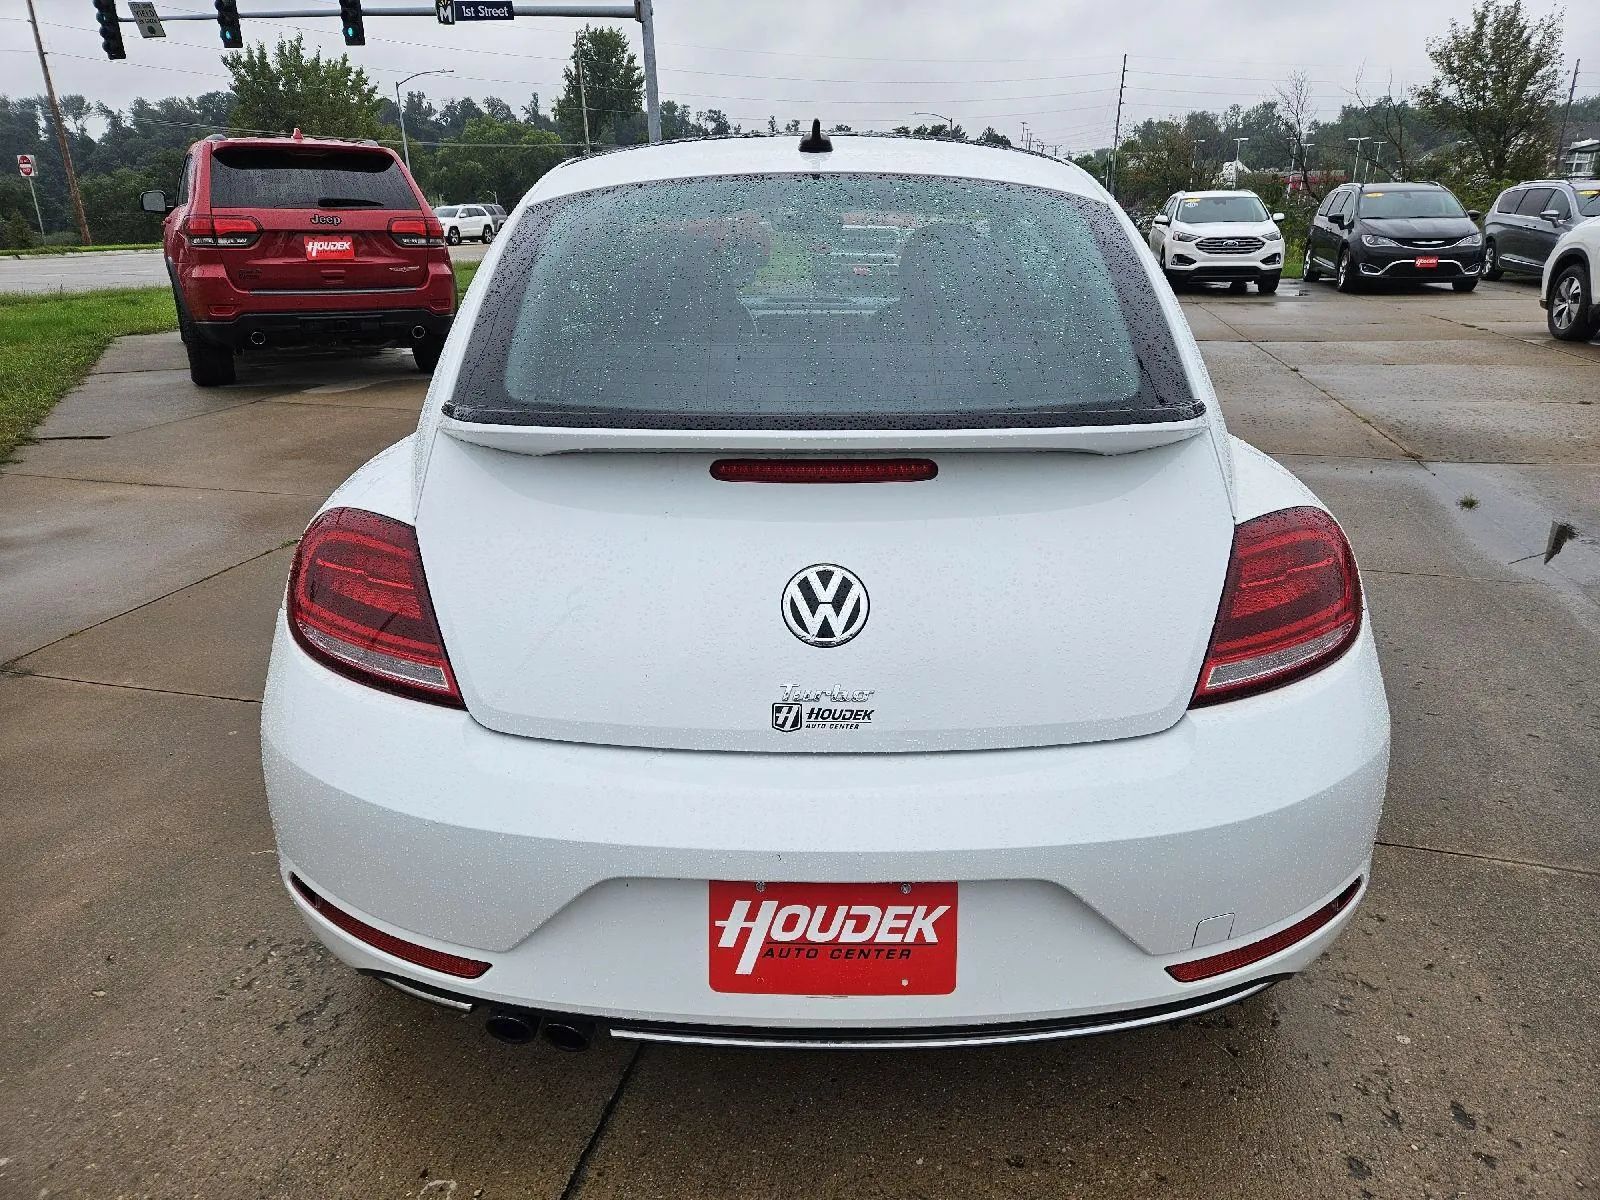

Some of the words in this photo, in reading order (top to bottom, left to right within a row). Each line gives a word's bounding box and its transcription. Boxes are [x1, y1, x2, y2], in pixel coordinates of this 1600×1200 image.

[461, 6, 475, 17] 1st
[478, 6, 509, 17] Street
[310, 214, 342, 226] Jeep
[305, 241, 351, 257] HOUDEK
[780, 683, 875, 702] Turbo
[806, 707, 875, 721] HOUDEK
[715, 900, 951, 975] HOUDEK
[762, 947, 819, 959] AUTO
[829, 948, 911, 960] CENTER
